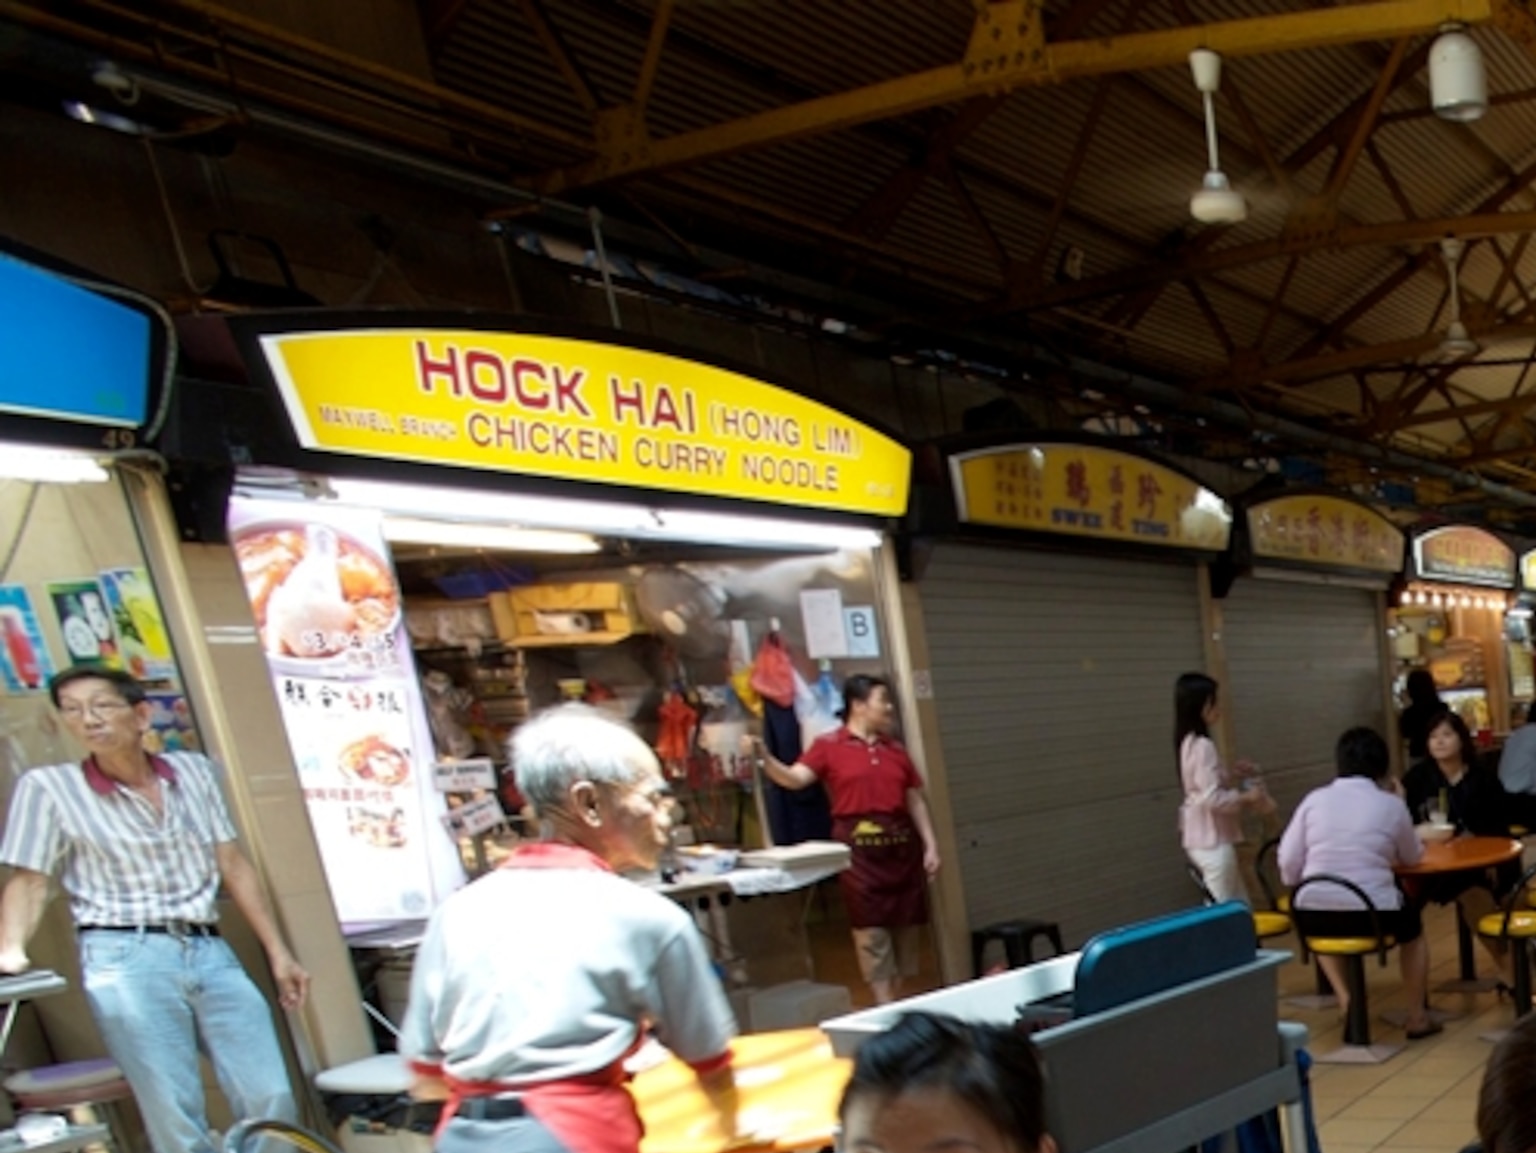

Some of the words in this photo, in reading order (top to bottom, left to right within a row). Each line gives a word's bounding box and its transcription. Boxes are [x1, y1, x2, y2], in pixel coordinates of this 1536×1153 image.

[318, 404, 395, 435] MAXWELL
[415, 340, 591, 417] HOCK
[610, 377, 696, 434] HAI
[709, 404, 801, 447] (HONG
[467, 412, 619, 464] CHICKEN
[634, 437, 728, 477] CURRY
[742, 455, 840, 494] NOODLE
[851, 612, 869, 637] B
